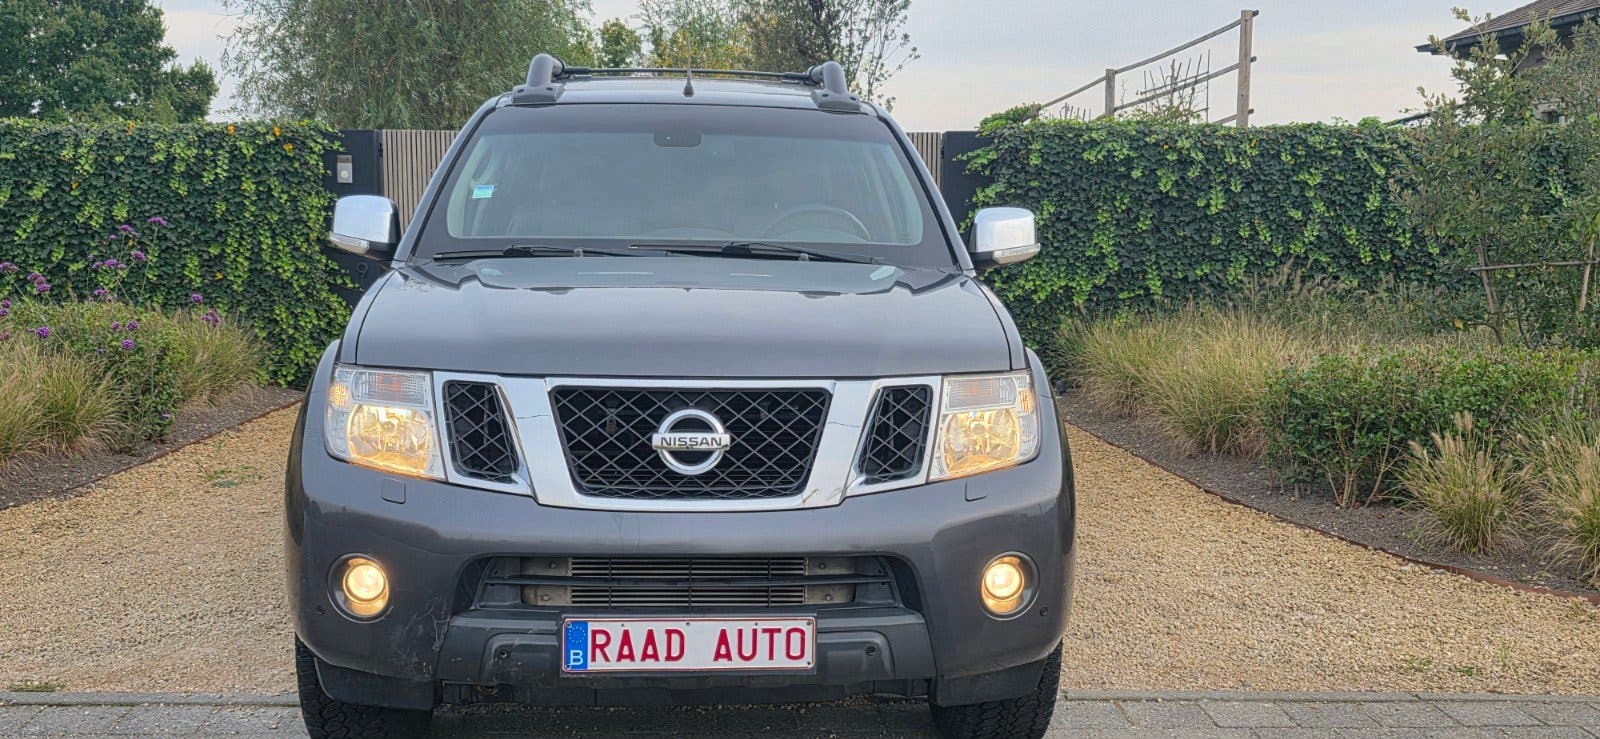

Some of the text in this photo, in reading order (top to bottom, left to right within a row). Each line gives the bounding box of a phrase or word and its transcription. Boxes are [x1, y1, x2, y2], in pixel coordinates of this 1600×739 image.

[660, 436, 722, 447] NISSAN
[590, 627, 806, 663] RAAD AUTO
[569, 650, 584, 666] B
